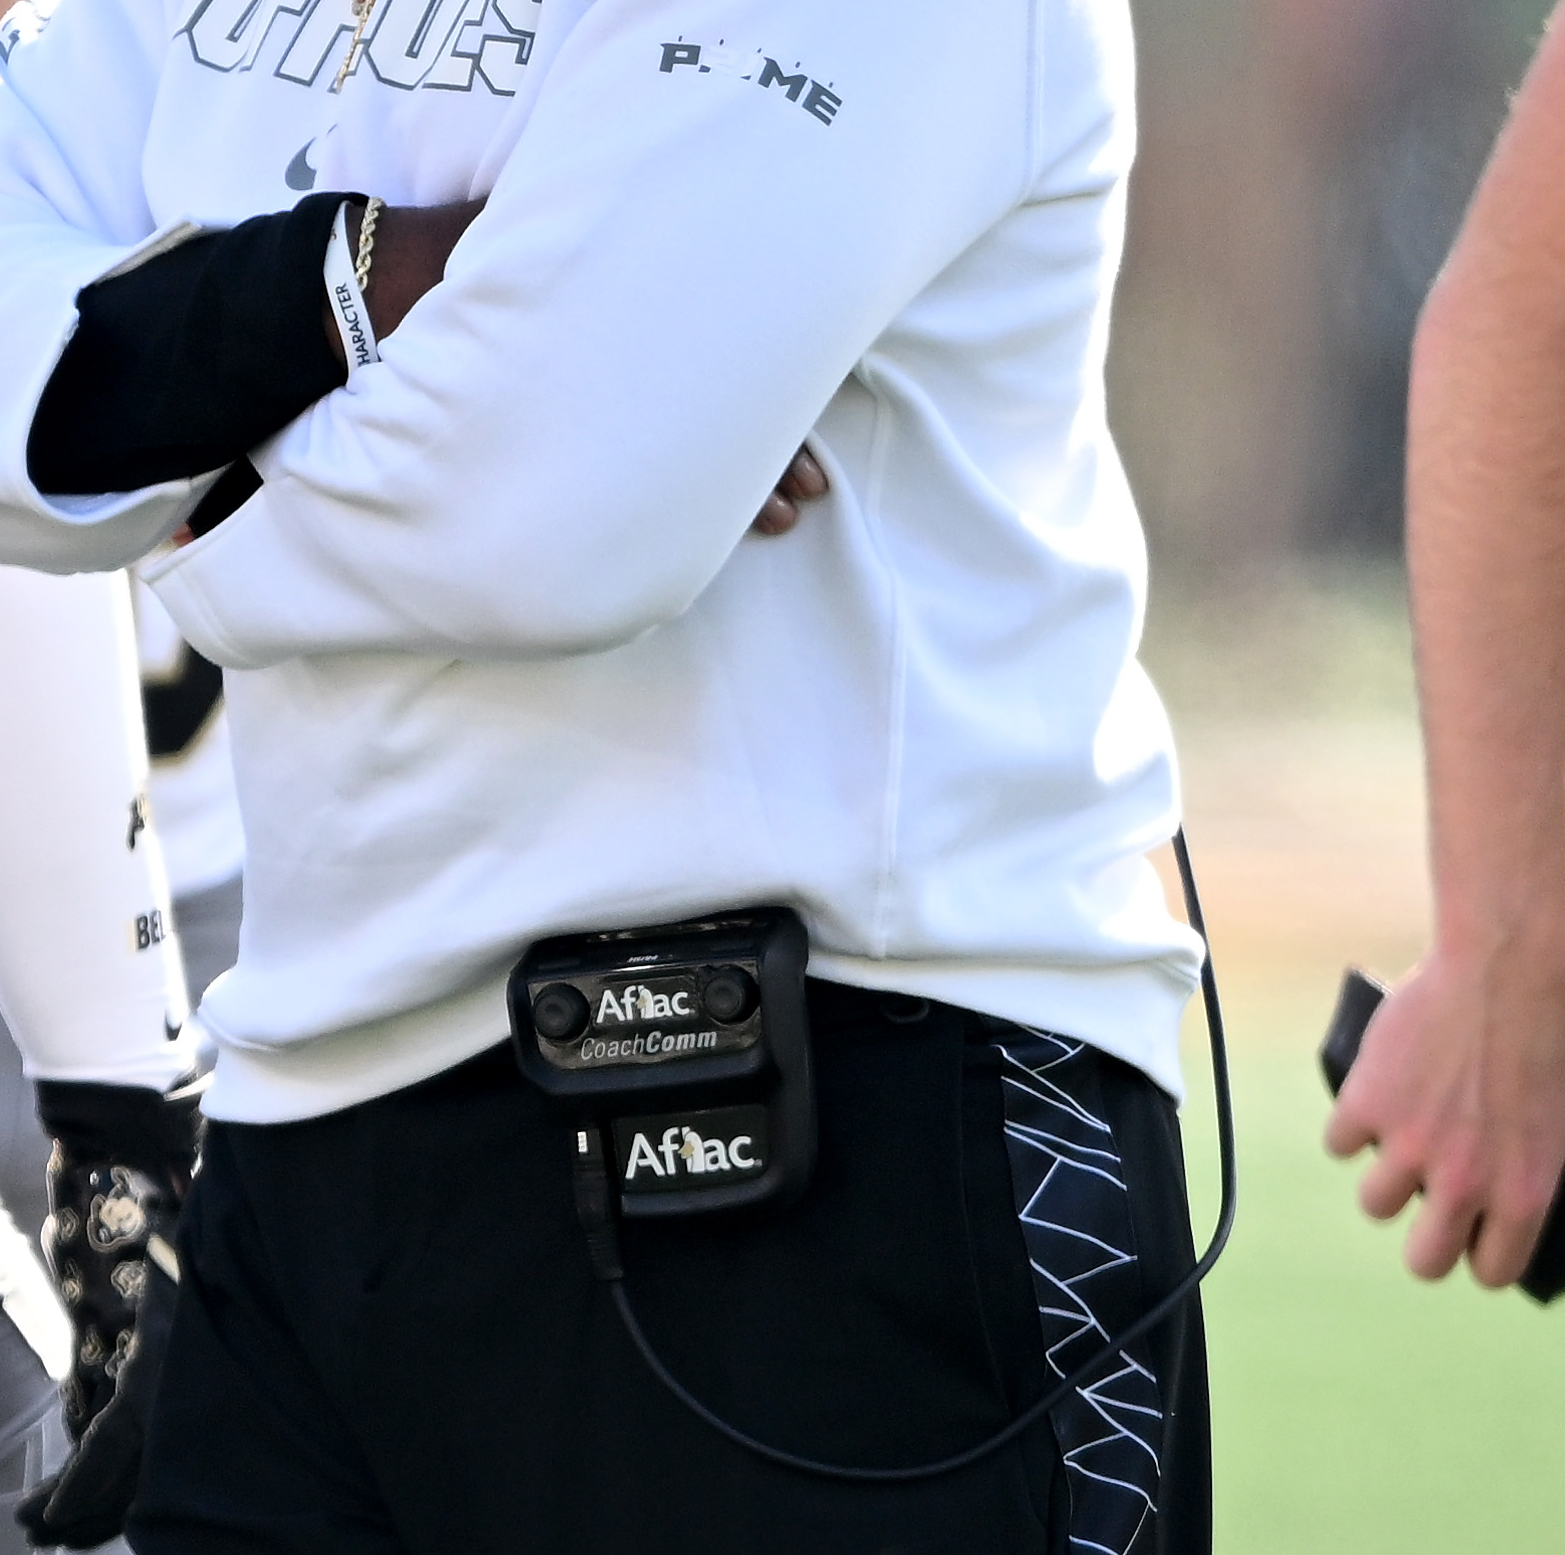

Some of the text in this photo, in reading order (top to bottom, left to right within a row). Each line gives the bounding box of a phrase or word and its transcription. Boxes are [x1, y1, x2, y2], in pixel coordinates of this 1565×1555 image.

[596, 984, 691, 1024] Aflac
[581, 1030, 718, 1061] CoachComm
[625, 1126, 755, 1180] Aflac
